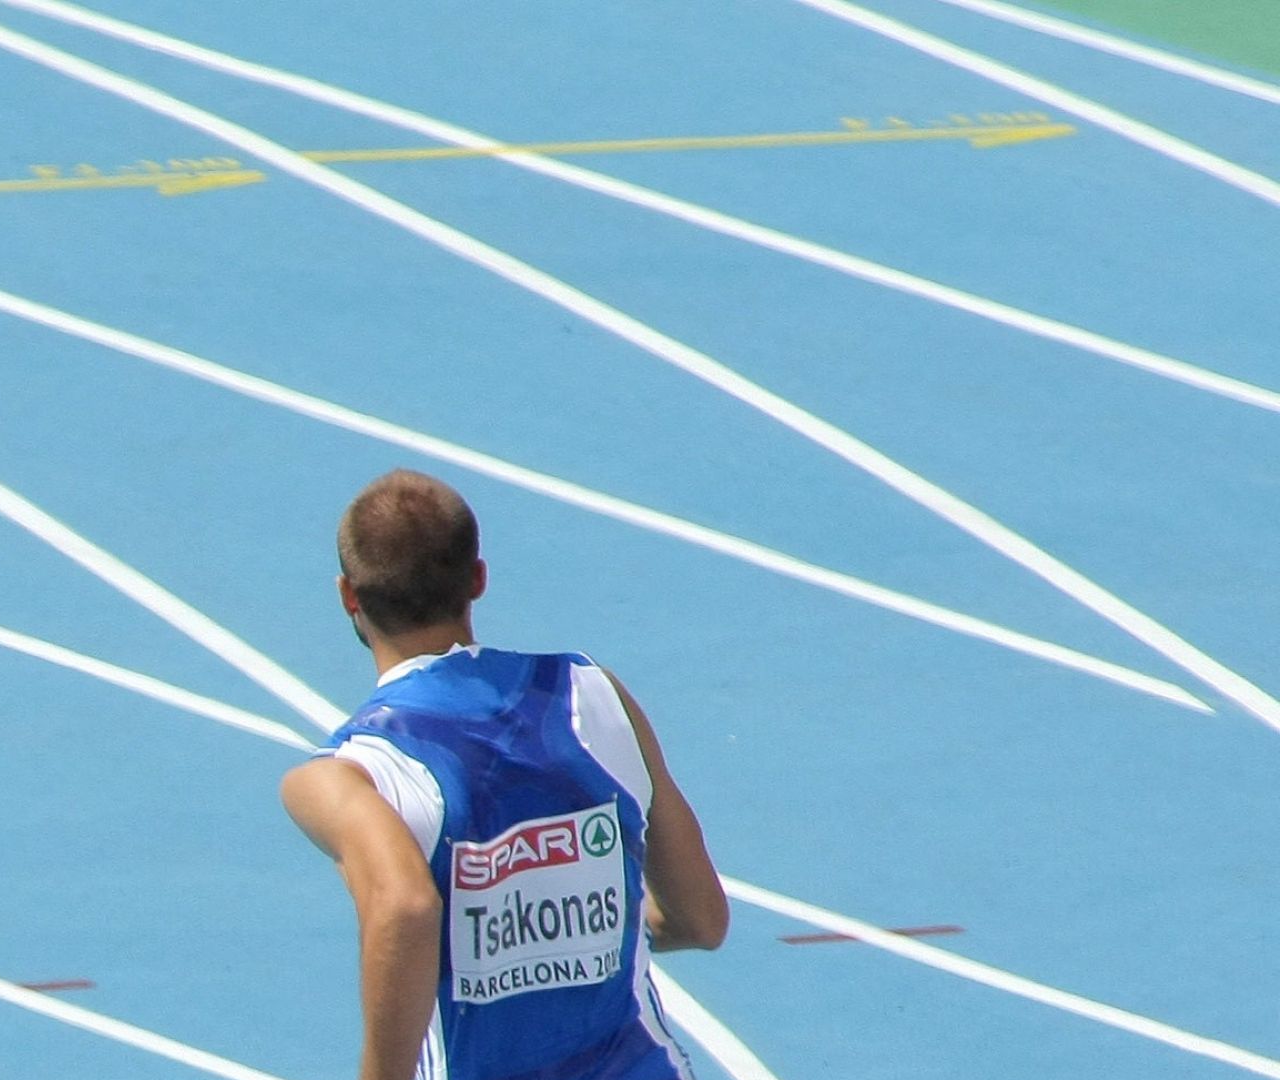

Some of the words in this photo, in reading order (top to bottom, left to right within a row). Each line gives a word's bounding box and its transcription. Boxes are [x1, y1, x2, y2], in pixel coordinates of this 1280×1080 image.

[460, 827, 575, 885] SPAR
[464, 886, 619, 960] Tsákonas
[460, 957, 588, 998] BARCELONA
